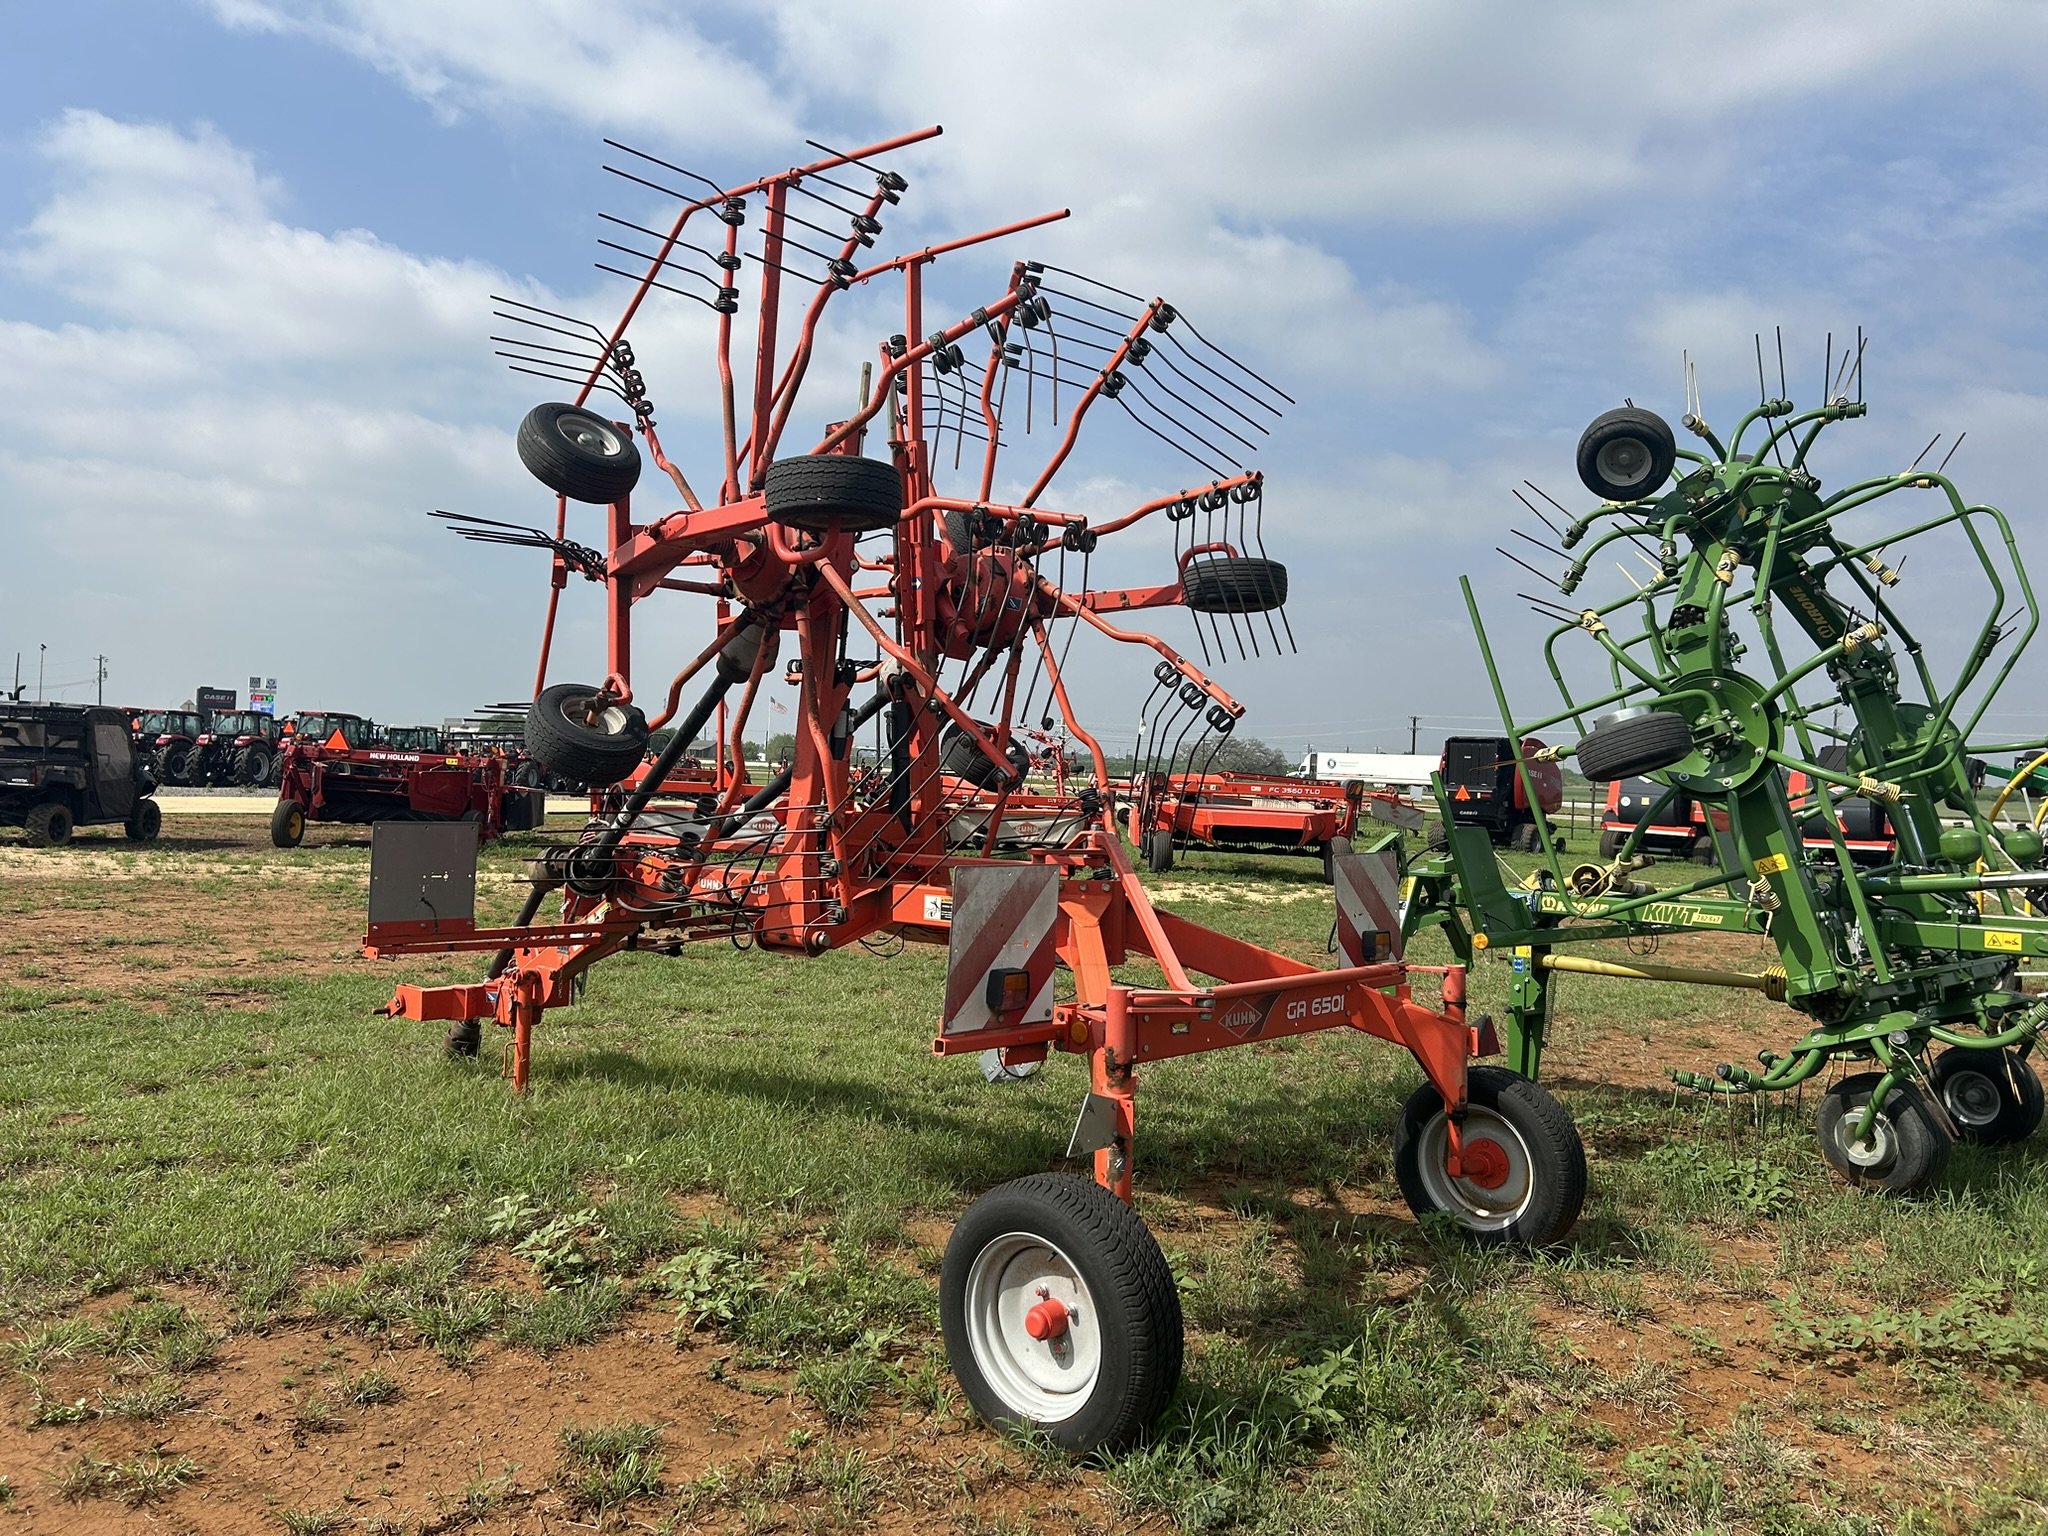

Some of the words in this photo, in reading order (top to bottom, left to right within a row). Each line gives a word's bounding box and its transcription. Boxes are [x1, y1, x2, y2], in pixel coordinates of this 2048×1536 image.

[1788, 585, 1829, 626] KRONE
[203, 693, 226, 701] CASE
[369, 752, 386, 760] NEW
[387, 753, 420, 762] HOLLAND
[1015, 825, 1039, 833] KUHN
[1642, 903, 1701, 926] KWT
[1286, 1001, 1307, 1020] GA
[1311, 994, 1345, 1016] 6501
[1224, 1010, 1256, 1028] KUHN
